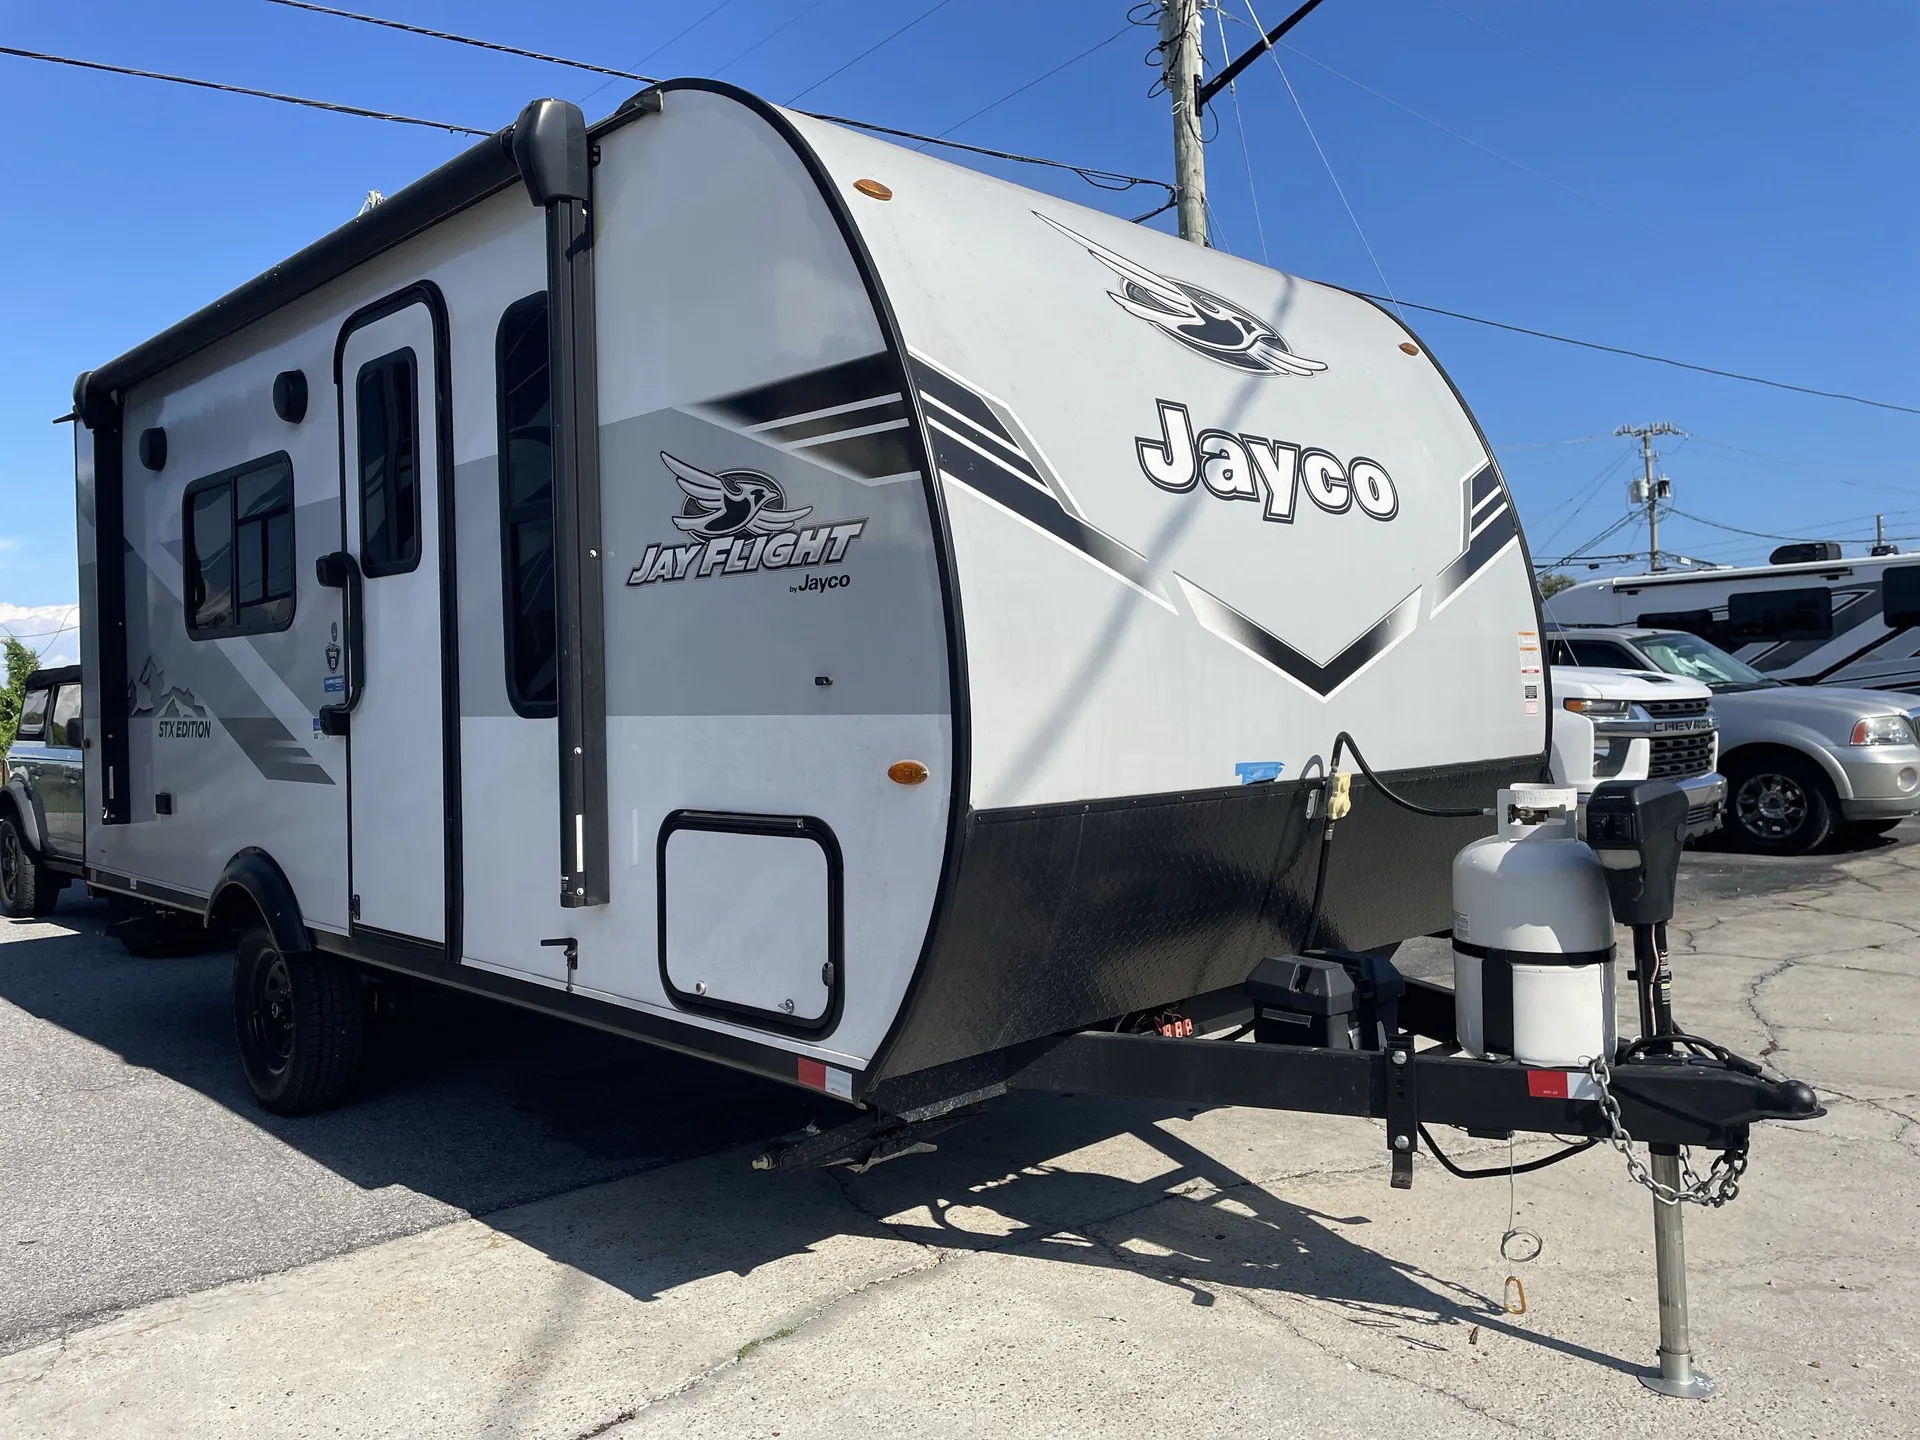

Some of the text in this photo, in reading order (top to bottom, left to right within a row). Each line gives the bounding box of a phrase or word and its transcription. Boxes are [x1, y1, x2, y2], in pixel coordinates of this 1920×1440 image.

[1134, 397, 1399, 524] Jayco
[625, 517, 870, 587] JAY FLIGHT
[798, 573, 851, 593] Jayco
[158, 720, 211, 738] STX EDITION
